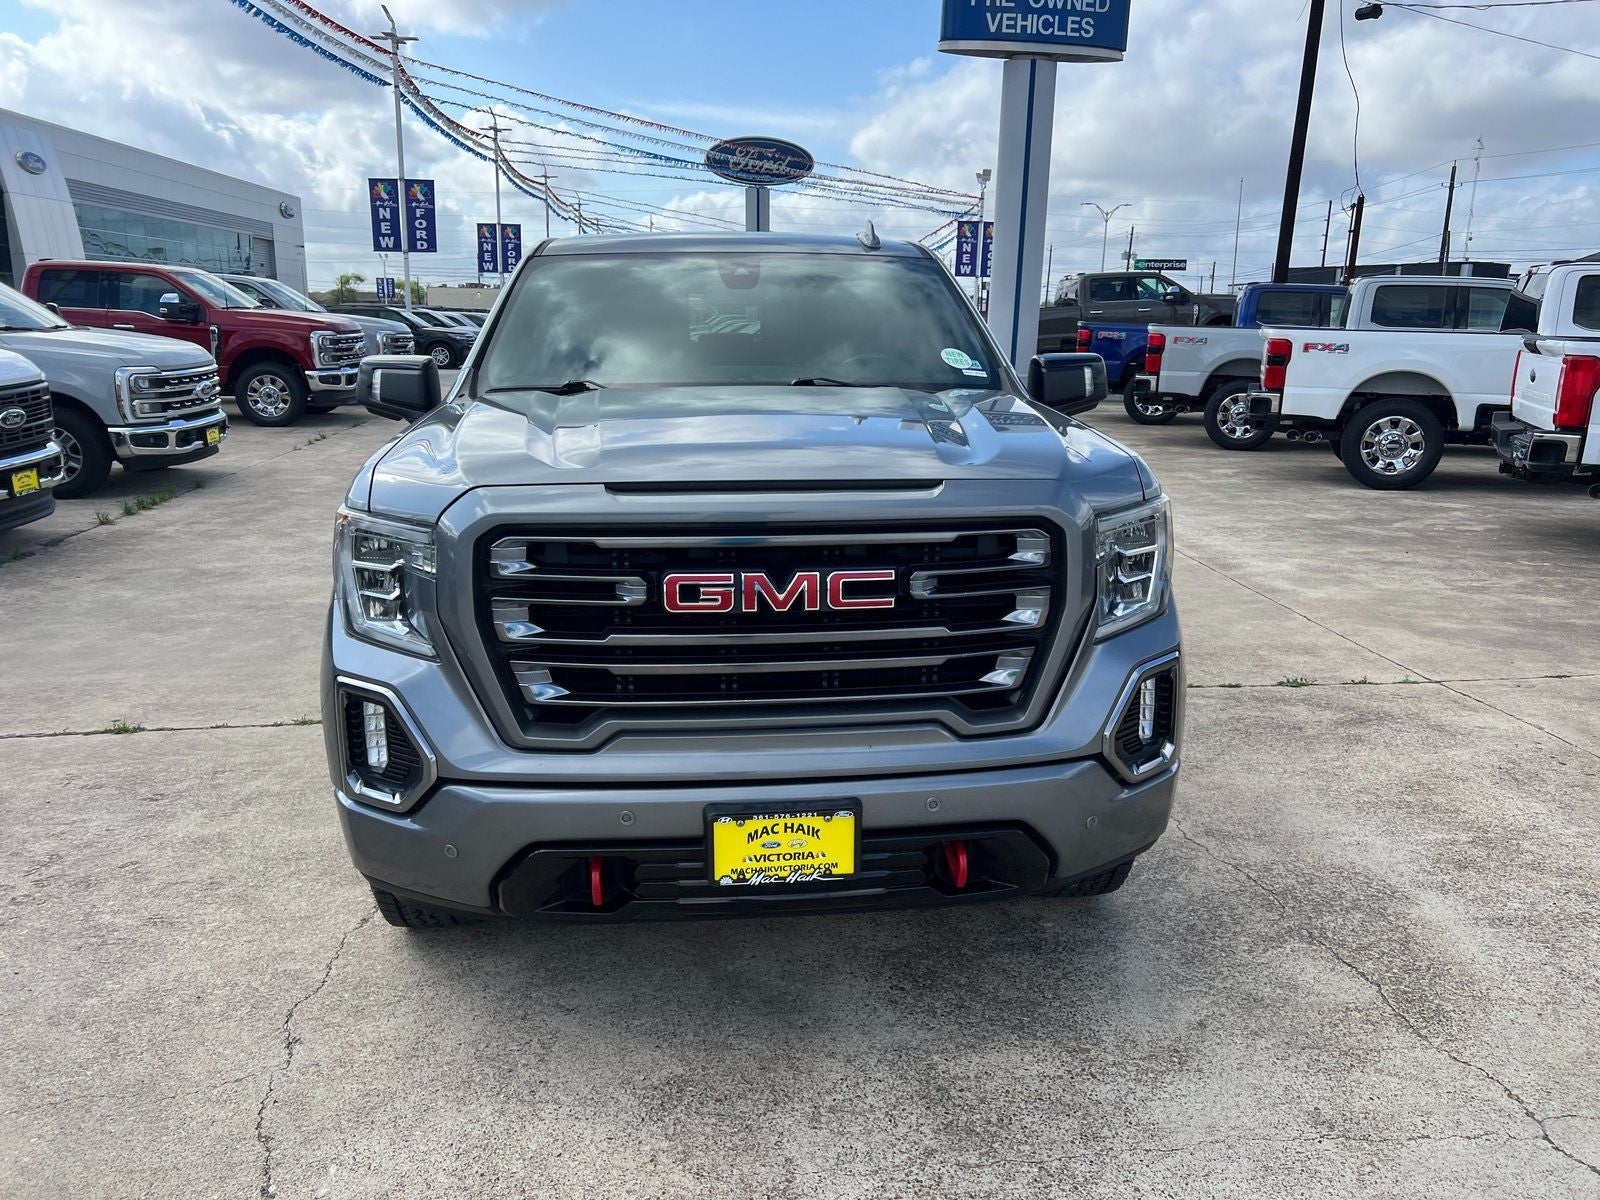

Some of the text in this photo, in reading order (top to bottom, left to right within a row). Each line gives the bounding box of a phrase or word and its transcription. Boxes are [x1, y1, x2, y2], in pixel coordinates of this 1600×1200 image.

[985, 13, 1095, 38] VEHICLES
[379, 207, 394, 248] NEW
[414, 208, 428, 250] FORD
[483, 243, 493, 270] NEW
[507, 243, 517, 272] FORD
[960, 242, 972, 275] NEW
[1137, 260, 1186, 269] enterprise
[1172, 336, 1208, 345] FX4
[1302, 342, 1350, 353] FX4
[944, 350, 964, 359] NEW
[663, 569, 896, 613] GMC
[746, 822, 822, 844] MAC HAIK
[753, 851, 816, 863] VICTORIA
[730, 862, 839, 875] MACHAIKVICTORIA.COM
[748, 869, 838, 885] Mac Haik
